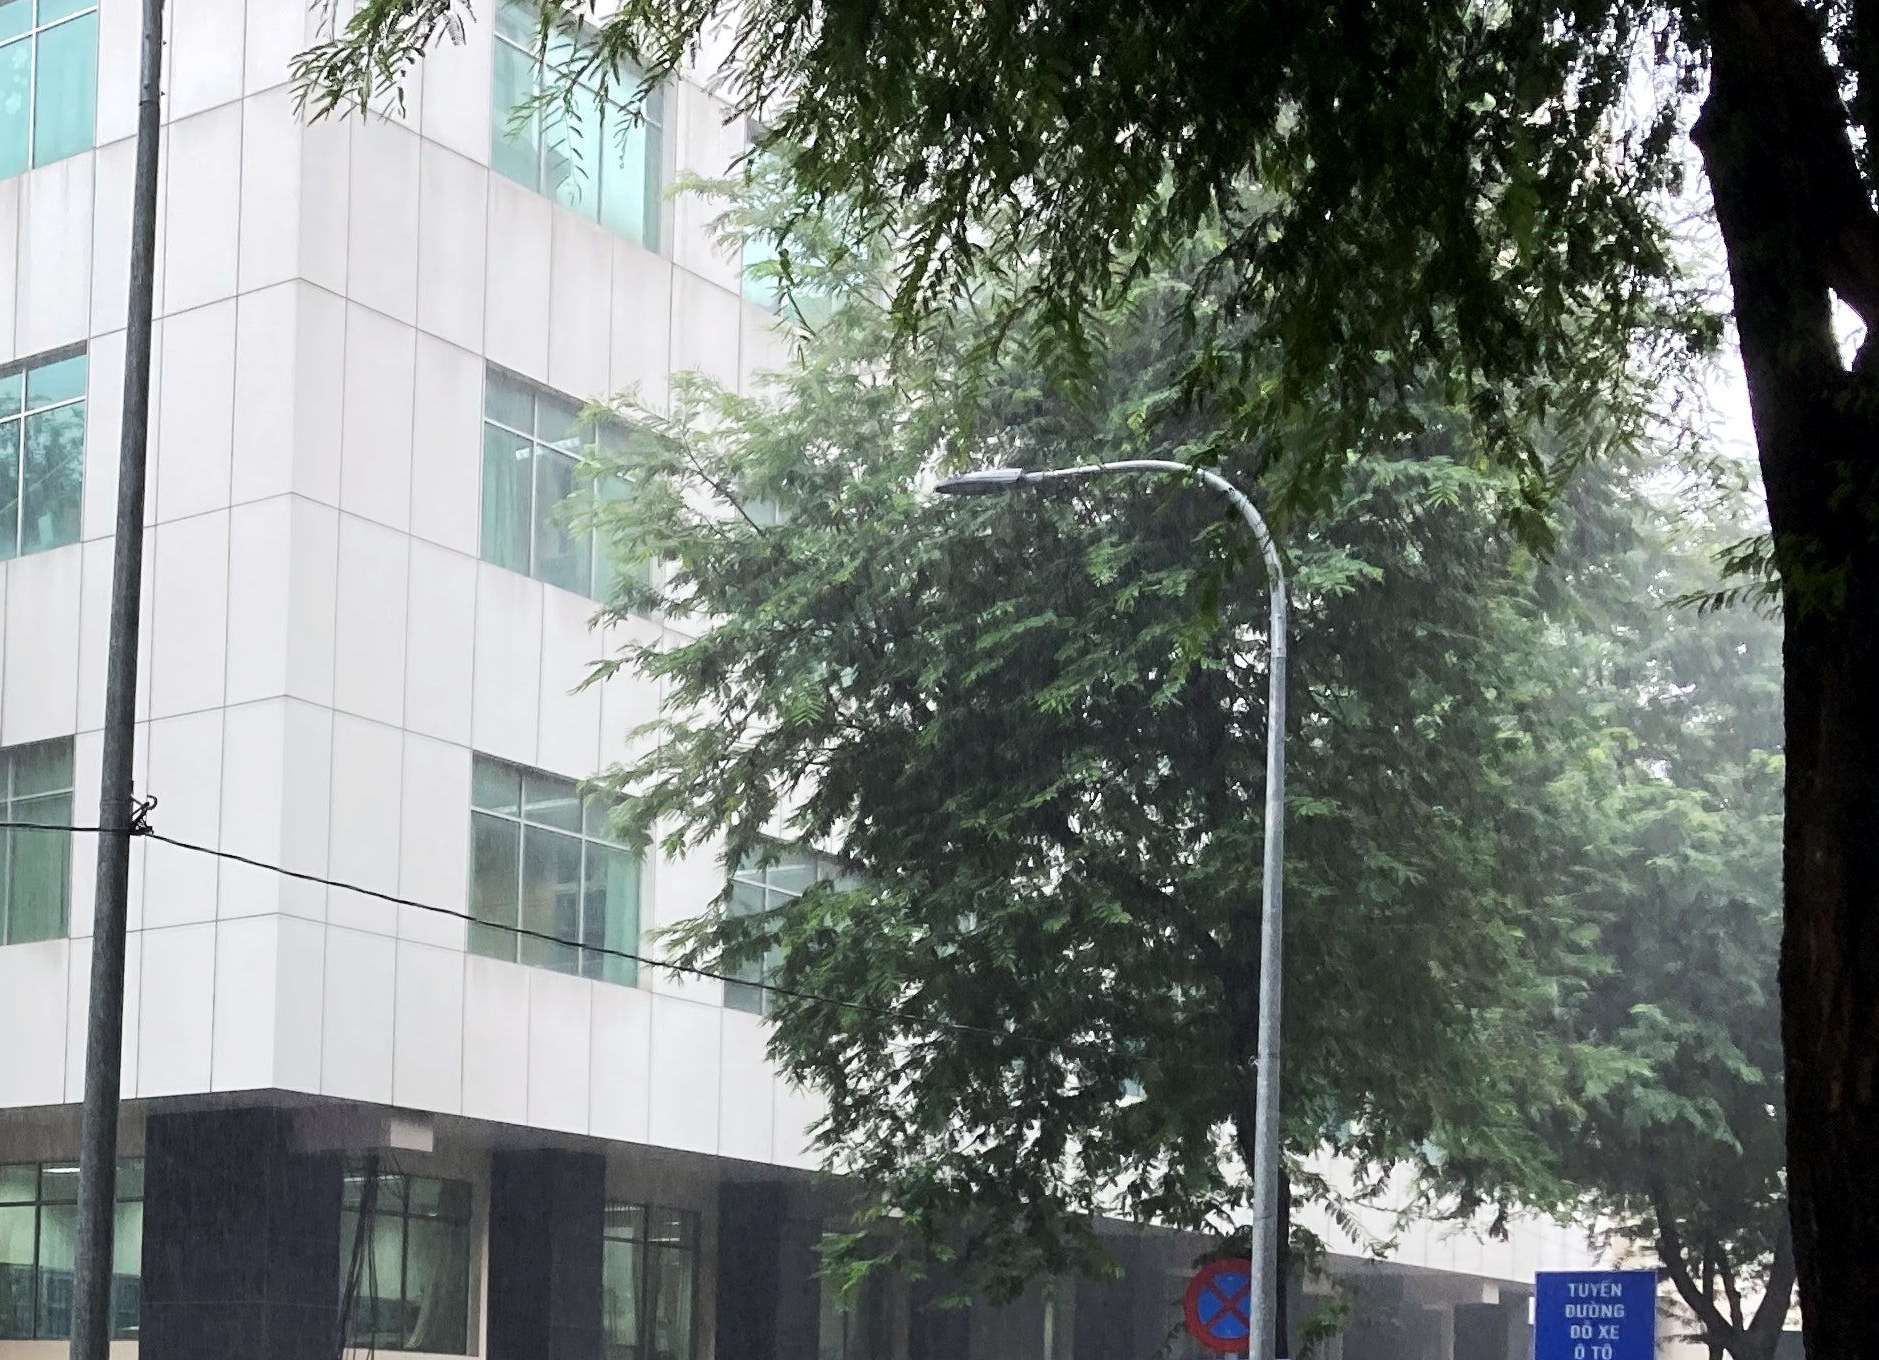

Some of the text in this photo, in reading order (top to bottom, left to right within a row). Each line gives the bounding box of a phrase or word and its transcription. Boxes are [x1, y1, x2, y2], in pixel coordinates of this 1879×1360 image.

[1568, 1280, 1621, 1298] TUYẾN
[1565, 1301, 1624, 1318] ĐƯỜNG
[1598, 1325, 1620, 1339] XE
[1574, 1344, 1612, 1360] Ô TÔ
